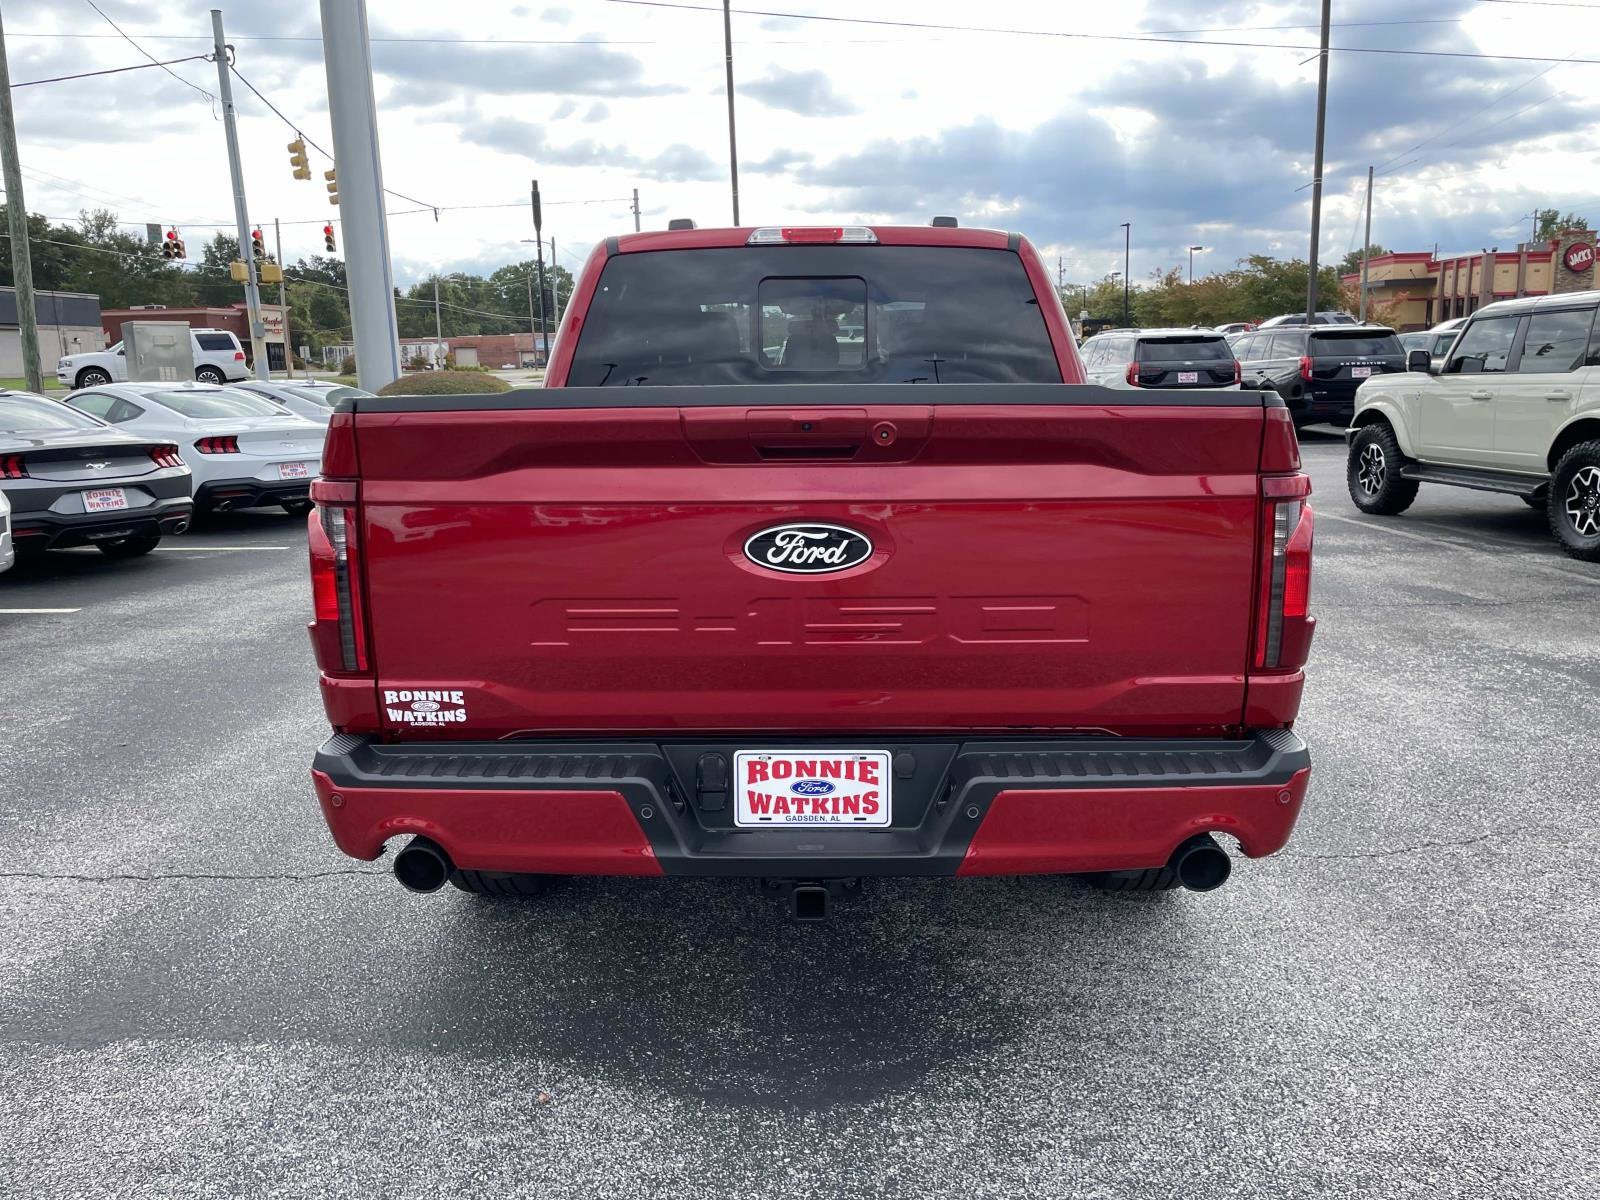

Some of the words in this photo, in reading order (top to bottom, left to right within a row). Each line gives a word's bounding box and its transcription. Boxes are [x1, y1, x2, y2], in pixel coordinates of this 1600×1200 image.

[88, 499, 124, 509] WATKINS
[766, 530, 849, 564] Ford
[530, 595, 1090, 645] F-150
[384, 690, 465, 705] RONNIE
[386, 707, 467, 722] WATKINS
[747, 760, 879, 786] RONNIE
[796, 781, 831, 795] Ford
[747, 790, 880, 815] WATKINS
[785, 814, 828, 823] GADSDEN,
[830, 814, 841, 823] AL
